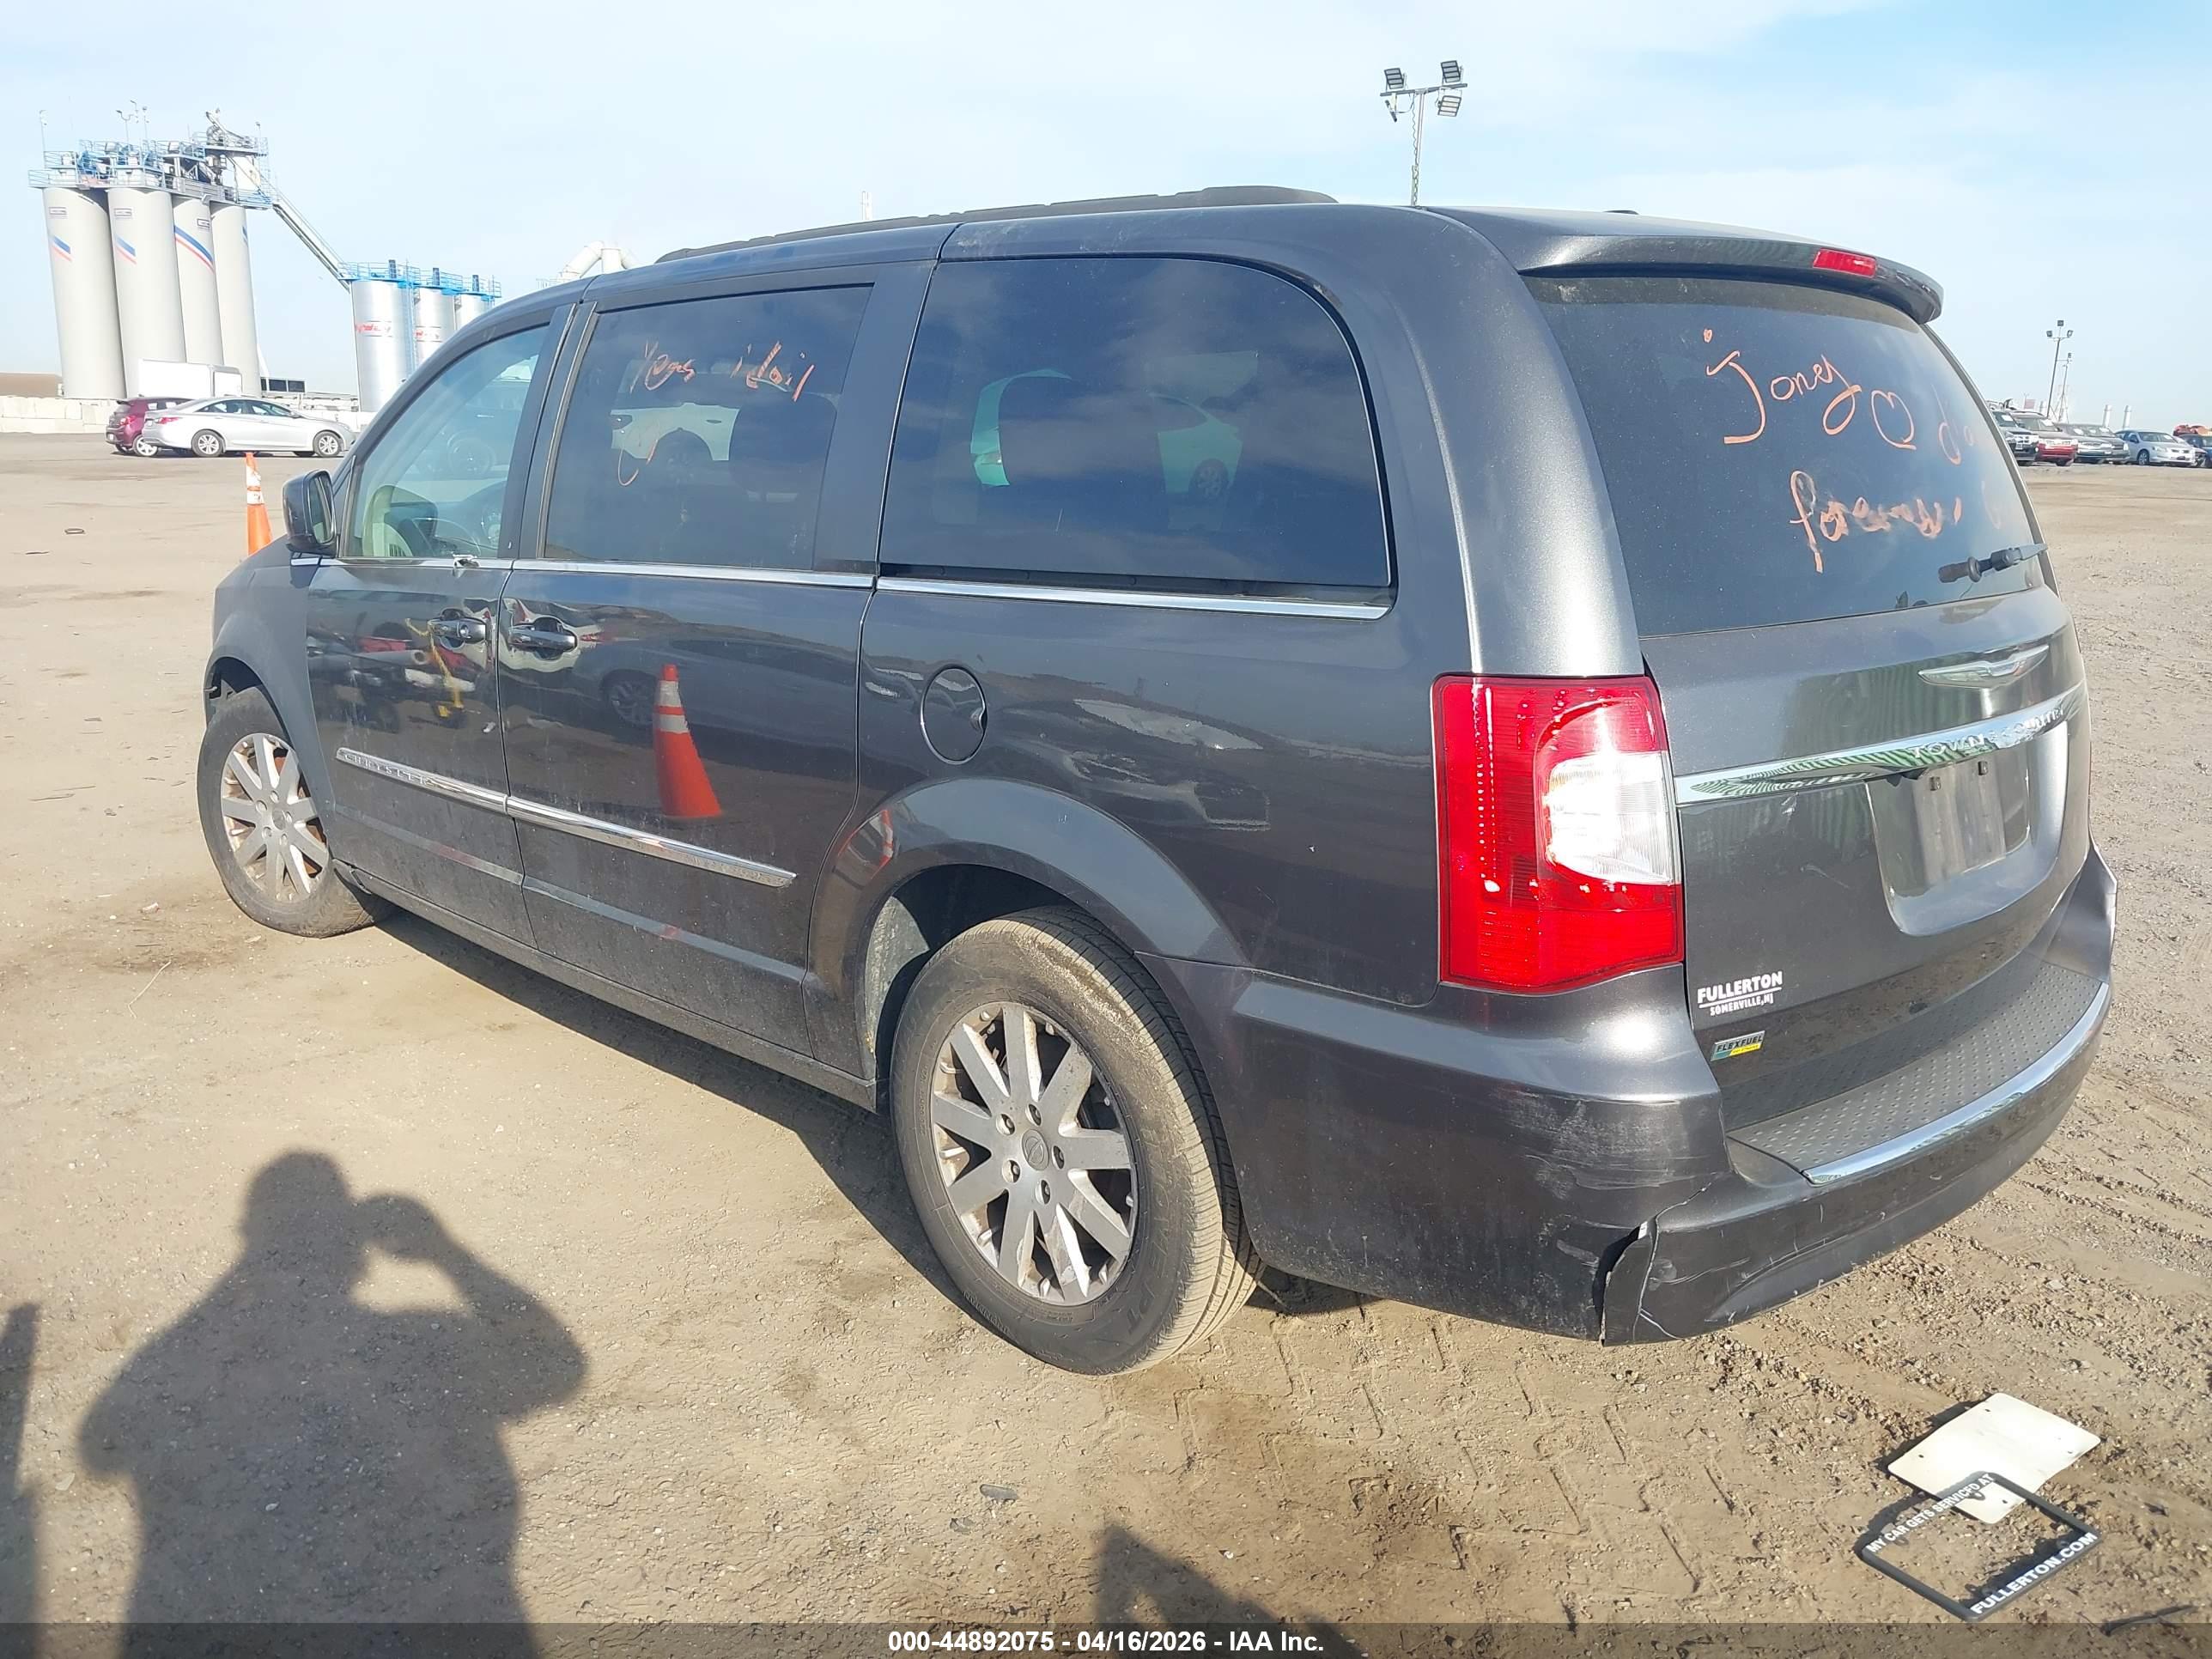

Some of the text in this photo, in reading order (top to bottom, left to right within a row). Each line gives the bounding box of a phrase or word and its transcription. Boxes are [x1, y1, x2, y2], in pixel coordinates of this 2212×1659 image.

[1911, 733, 1984, 758] TOWN
[2000, 708, 2064, 738] COUNTRY
[1697, 971, 1784, 1004] FULLERTON
[1866, 1474, 1995, 1553] MY CAR GETS SERVICED AT
[1970, 1532, 2099, 1615] FULLERTON.COM
